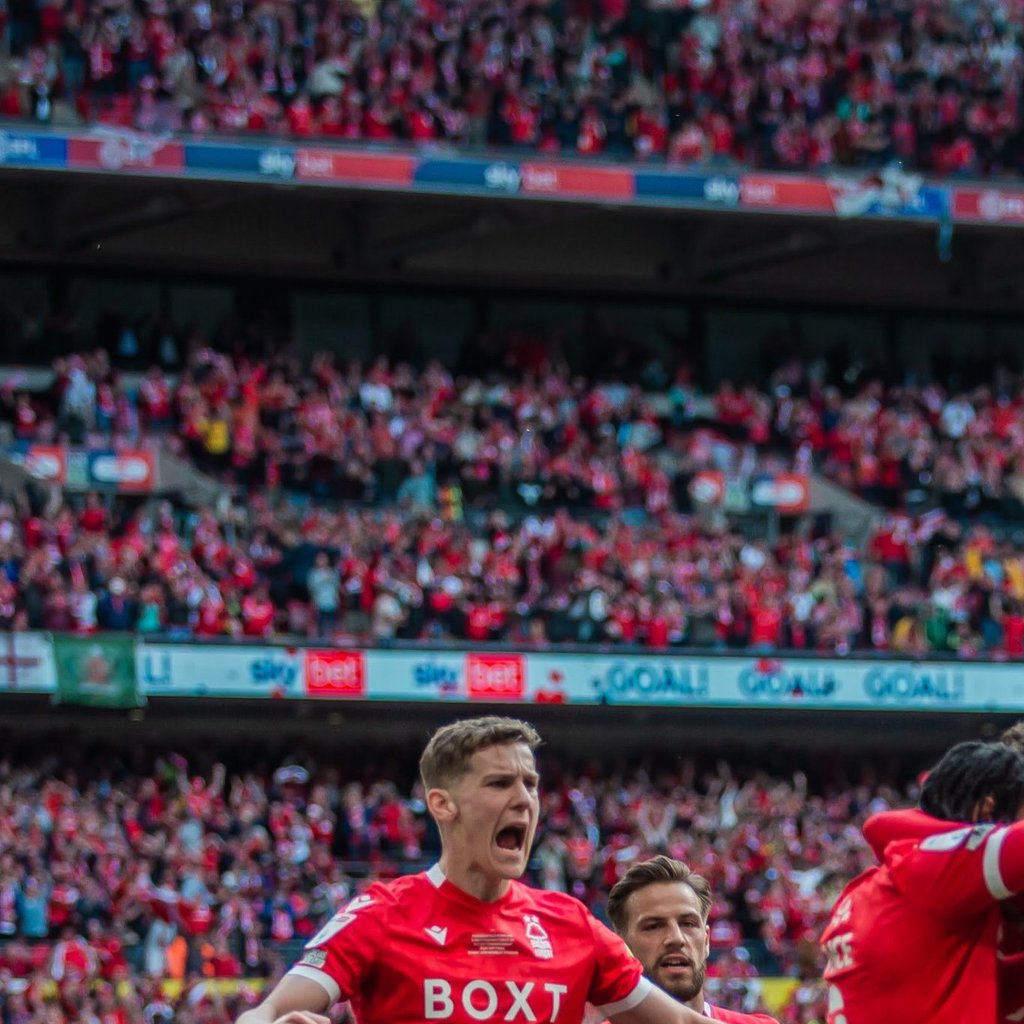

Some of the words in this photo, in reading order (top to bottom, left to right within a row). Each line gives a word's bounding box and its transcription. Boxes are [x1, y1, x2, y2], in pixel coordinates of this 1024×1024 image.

[308, 656, 361, 688] bet
[471, 662, 524, 692] bet
[424, 978, 567, 1023] BOXT
